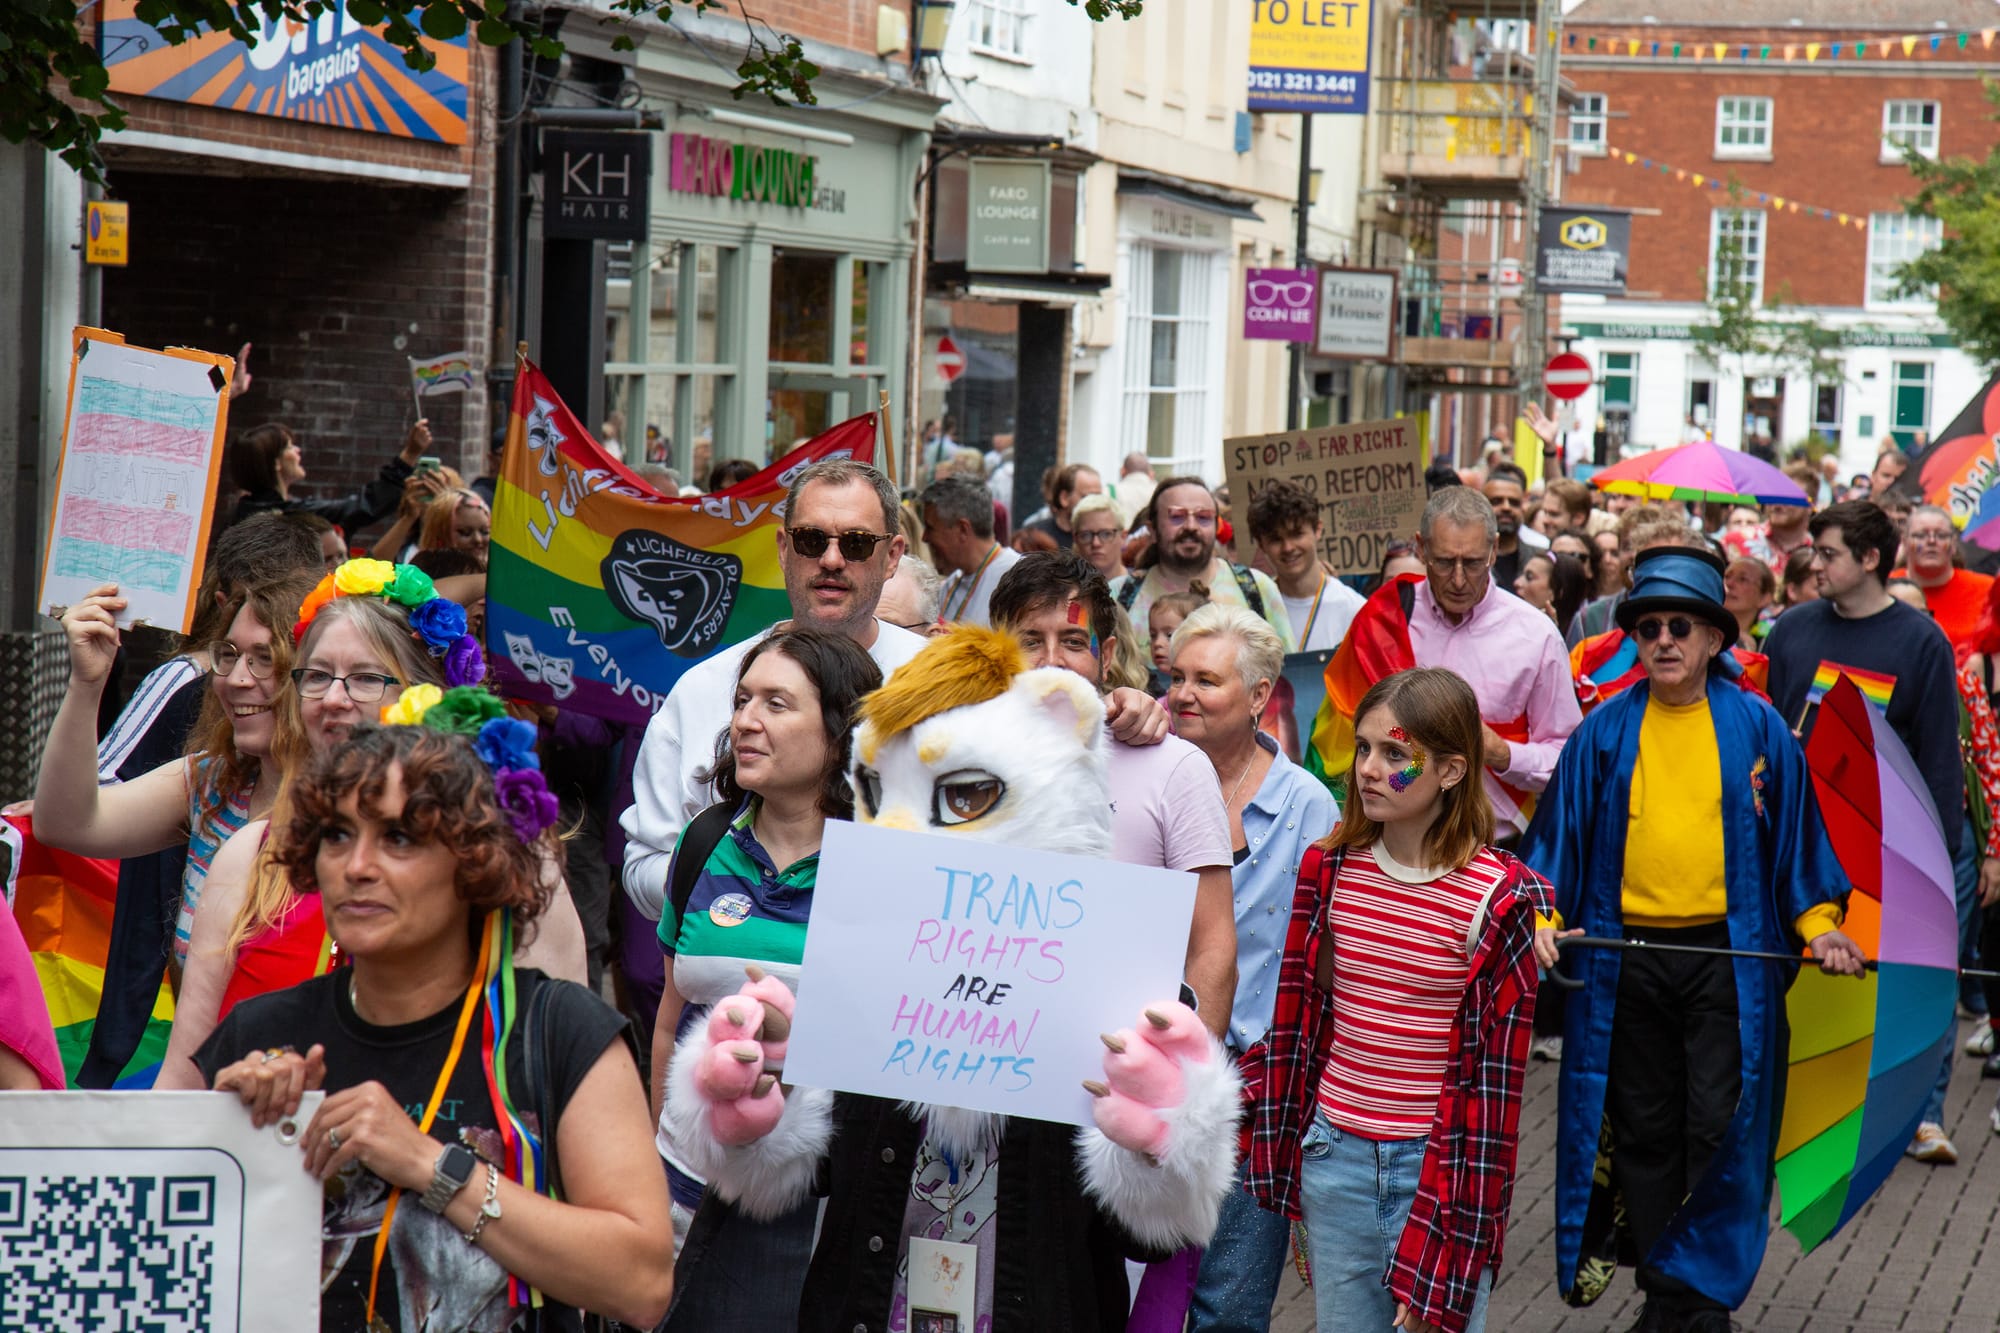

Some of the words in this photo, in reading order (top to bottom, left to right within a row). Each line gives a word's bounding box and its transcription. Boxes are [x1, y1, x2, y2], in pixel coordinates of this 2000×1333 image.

[1253, 0, 1289, 24] TO
[1302, 1, 1359, 28] LET
[288, 41, 360, 99] bargains
[1248, 71, 1281, 88] 0121
[1283, 73, 1312, 90] 321
[1315, 74, 1356, 92] 3441
[562, 151, 630, 197] KH
[673, 133, 735, 198] FARO
[738, 144, 819, 208] LOUNGE
[989, 186, 1028, 200] FARO
[562, 202, 629, 220] HAIR
[976, 205, 1039, 220] LOUNGE
[1329, 281, 1386, 304] Trinity
[1246, 305, 1288, 323] COLIN
[1290, 308, 1312, 324] LEE
[1329, 303, 1384, 321] House
[1235, 441, 1292, 471] STOP
[1318, 436, 1349, 460] FAR
[635, 537, 727, 566] LICHFIELD
[703, 564, 738, 641] PLAYERS
[549, 606, 665, 715] Everyon
[935, 866, 1084, 930] TRANS
[908, 919, 1065, 983] RIGHTS
[943, 973, 1013, 1006] ARE
[891, 994, 1041, 1055] HUMAN
[881, 1038, 1035, 1093] RIGHTS
